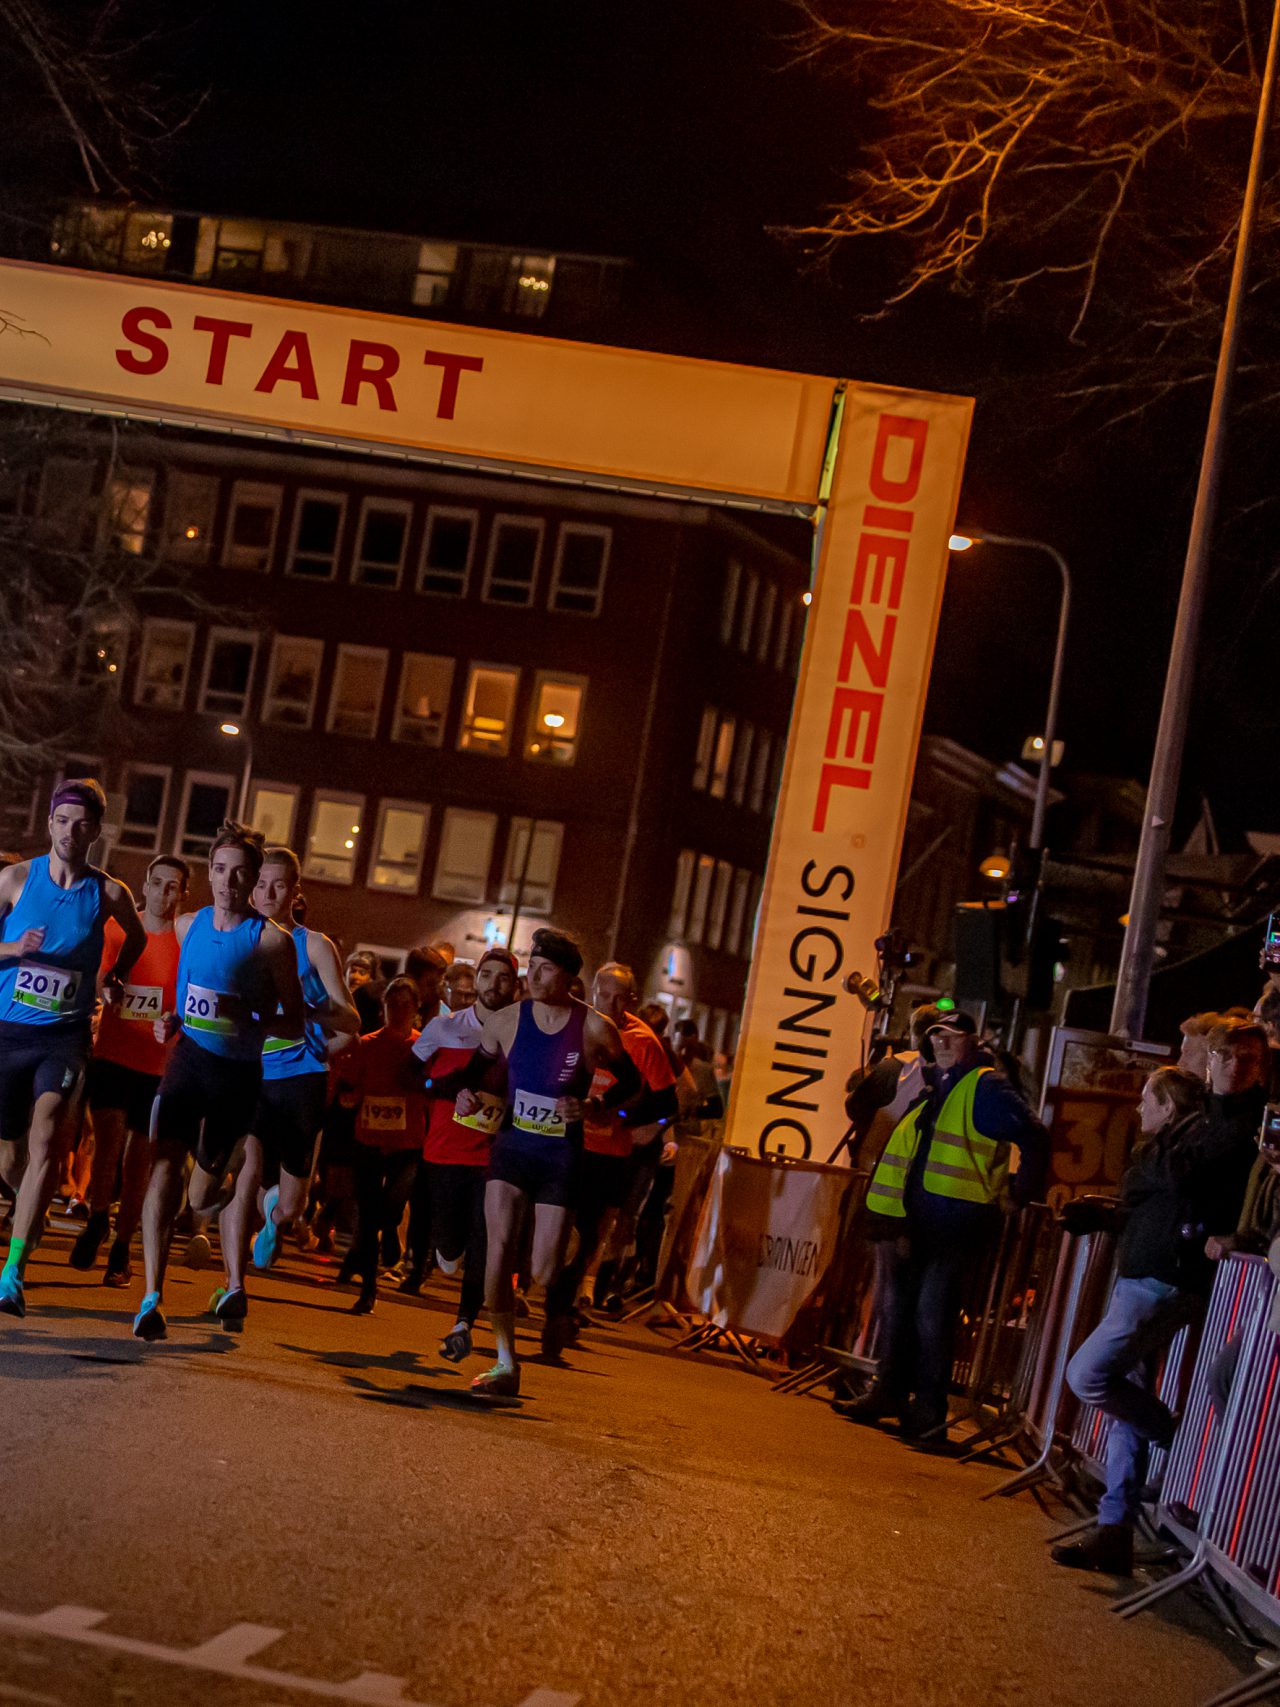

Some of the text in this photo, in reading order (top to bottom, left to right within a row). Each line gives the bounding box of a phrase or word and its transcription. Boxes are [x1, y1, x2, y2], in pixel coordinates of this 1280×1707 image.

[115, 306, 484, 420] START
[759, 413, 929, 1160] DIEZEL SIGNING
[18, 970, 76, 999] 2010
[519, 1101, 562, 1125] 1475
